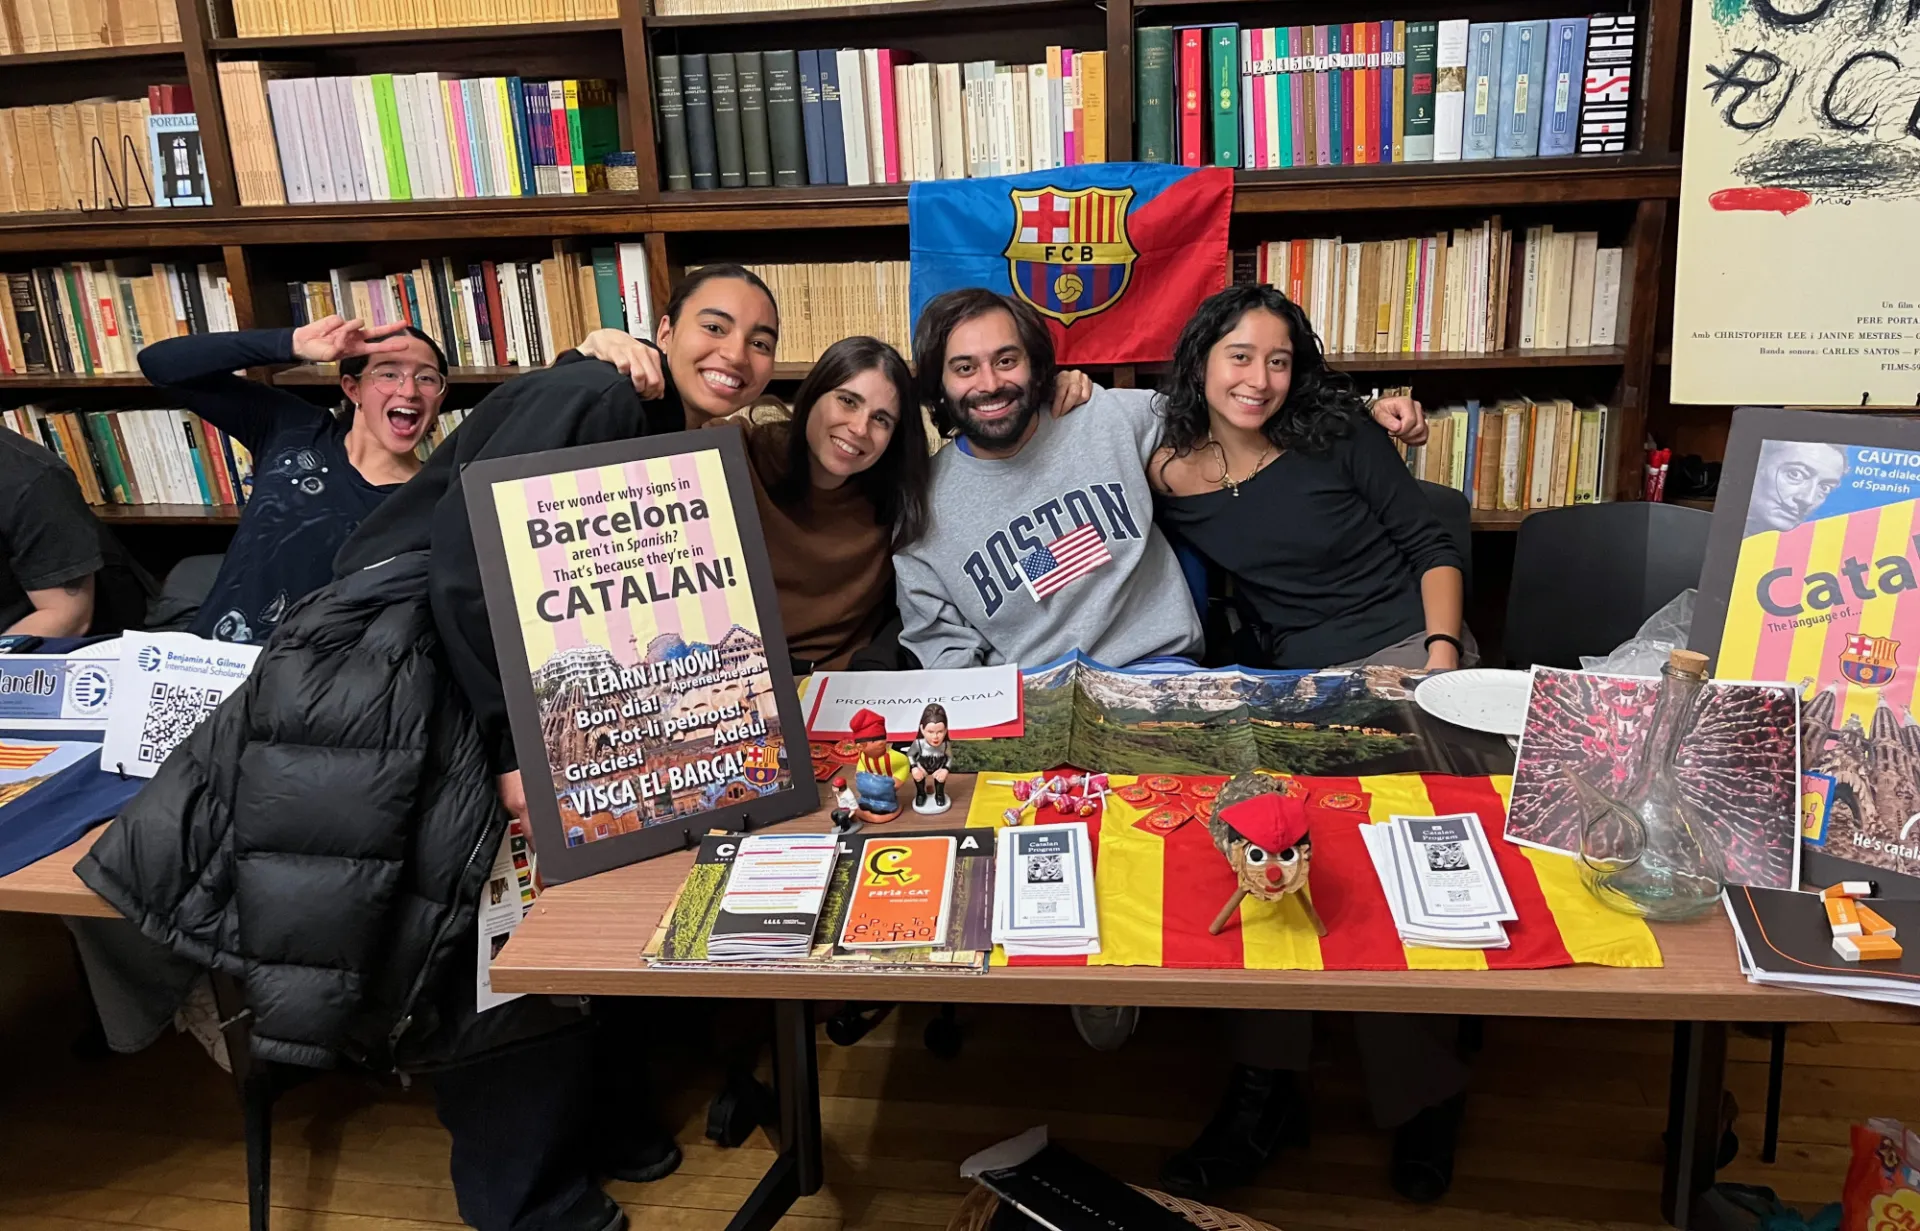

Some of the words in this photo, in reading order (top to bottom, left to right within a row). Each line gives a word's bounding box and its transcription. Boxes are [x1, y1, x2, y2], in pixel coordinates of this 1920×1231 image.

[1267, 60, 1272, 70] 3
[1280, 58, 1286, 70] 4
[1293, 58, 1299, 69] 5
[1306, 56, 1312, 68] 6
[1318, 58, 1324, 68] 7
[1331, 54, 1338, 66] 8
[1344, 54, 1350, 66] 9
[1354, 54, 1365, 66] 10
[1368, 54, 1378, 66] 11
[1383, 52, 1392, 64] 12
[1394, 53, 1404, 64] 13
[1244, 60, 1249, 72] 1
[1256, 62, 1262, 73] 2
[1418, 107, 1424, 118] 3
[1045, 246, 1093, 262] FCB
[1881, 301, 1894, 309] Un
[1897, 301, 1913, 309] film
[1857, 317, 1883, 325] PERE
[1887, 317, 1920, 325] PORTA
[1692, 331, 1711, 340] Amb
[1714, 331, 1783, 340] CHRISTOPHER
[1787, 332, 1807, 340] LEE
[1810, 332, 1814, 340] i
[1818, 332, 1855, 340] JANINE
[1858, 332, 1902, 340] MESTRES
[1759, 347, 1785, 355] Banda
[1822, 347, 1859, 356] CARLES
[1863, 347, 1900, 356] SANTOS
[1855, 466, 1880, 478] NOT
[1881, 471, 1887, 479] a
[1852, 480, 1864, 489] of
[1865, 480, 1910, 494] Spanish
[537, 499, 565, 513] Ever
[567, 491, 615, 508] wonder
[618, 486, 643, 501] why
[646, 482, 677, 498] signs
[678, 478, 690, 491] in
[526, 498, 709, 549] Barcelona
[611, 541, 625, 553] in
[627, 530, 678, 554] Spanish?
[962, 482, 1144, 620] BOSTON
[595, 553, 645, 575] because
[692, 545, 704, 557] in
[536, 557, 737, 624] CATALAN!
[1767, 623, 1787, 634] The
[1788, 612, 1839, 629] language
[167, 651, 204, 663] Benjamin
[205, 655, 214, 665] A.
[216, 658, 246, 669] Gilman
[164, 661, 209, 675] International
[586, 667, 649, 697] LEARN
[649, 660, 671, 684] IT
[670, 648, 722, 679] NOW!
[670, 669, 740, 693] Apreneu-ne
[740, 663, 763, 678] ara!
[835, 697, 922, 706] PROGRAMA
[950, 689, 1004, 702] CATALÀ
[576, 707, 618, 730] Bon
[621, 695, 660, 719] dia!
[608, 724, 661, 747] Fot-li
[665, 701, 742, 737] pebrots!
[713, 719, 767, 746] Adéu!
[565, 748, 644, 782] Gràcies!
[570, 783, 637, 815] VISCA
[639, 773, 667, 800] EL
[668, 750, 744, 793] BARÇA!
[1853, 832, 1881, 851] He's
